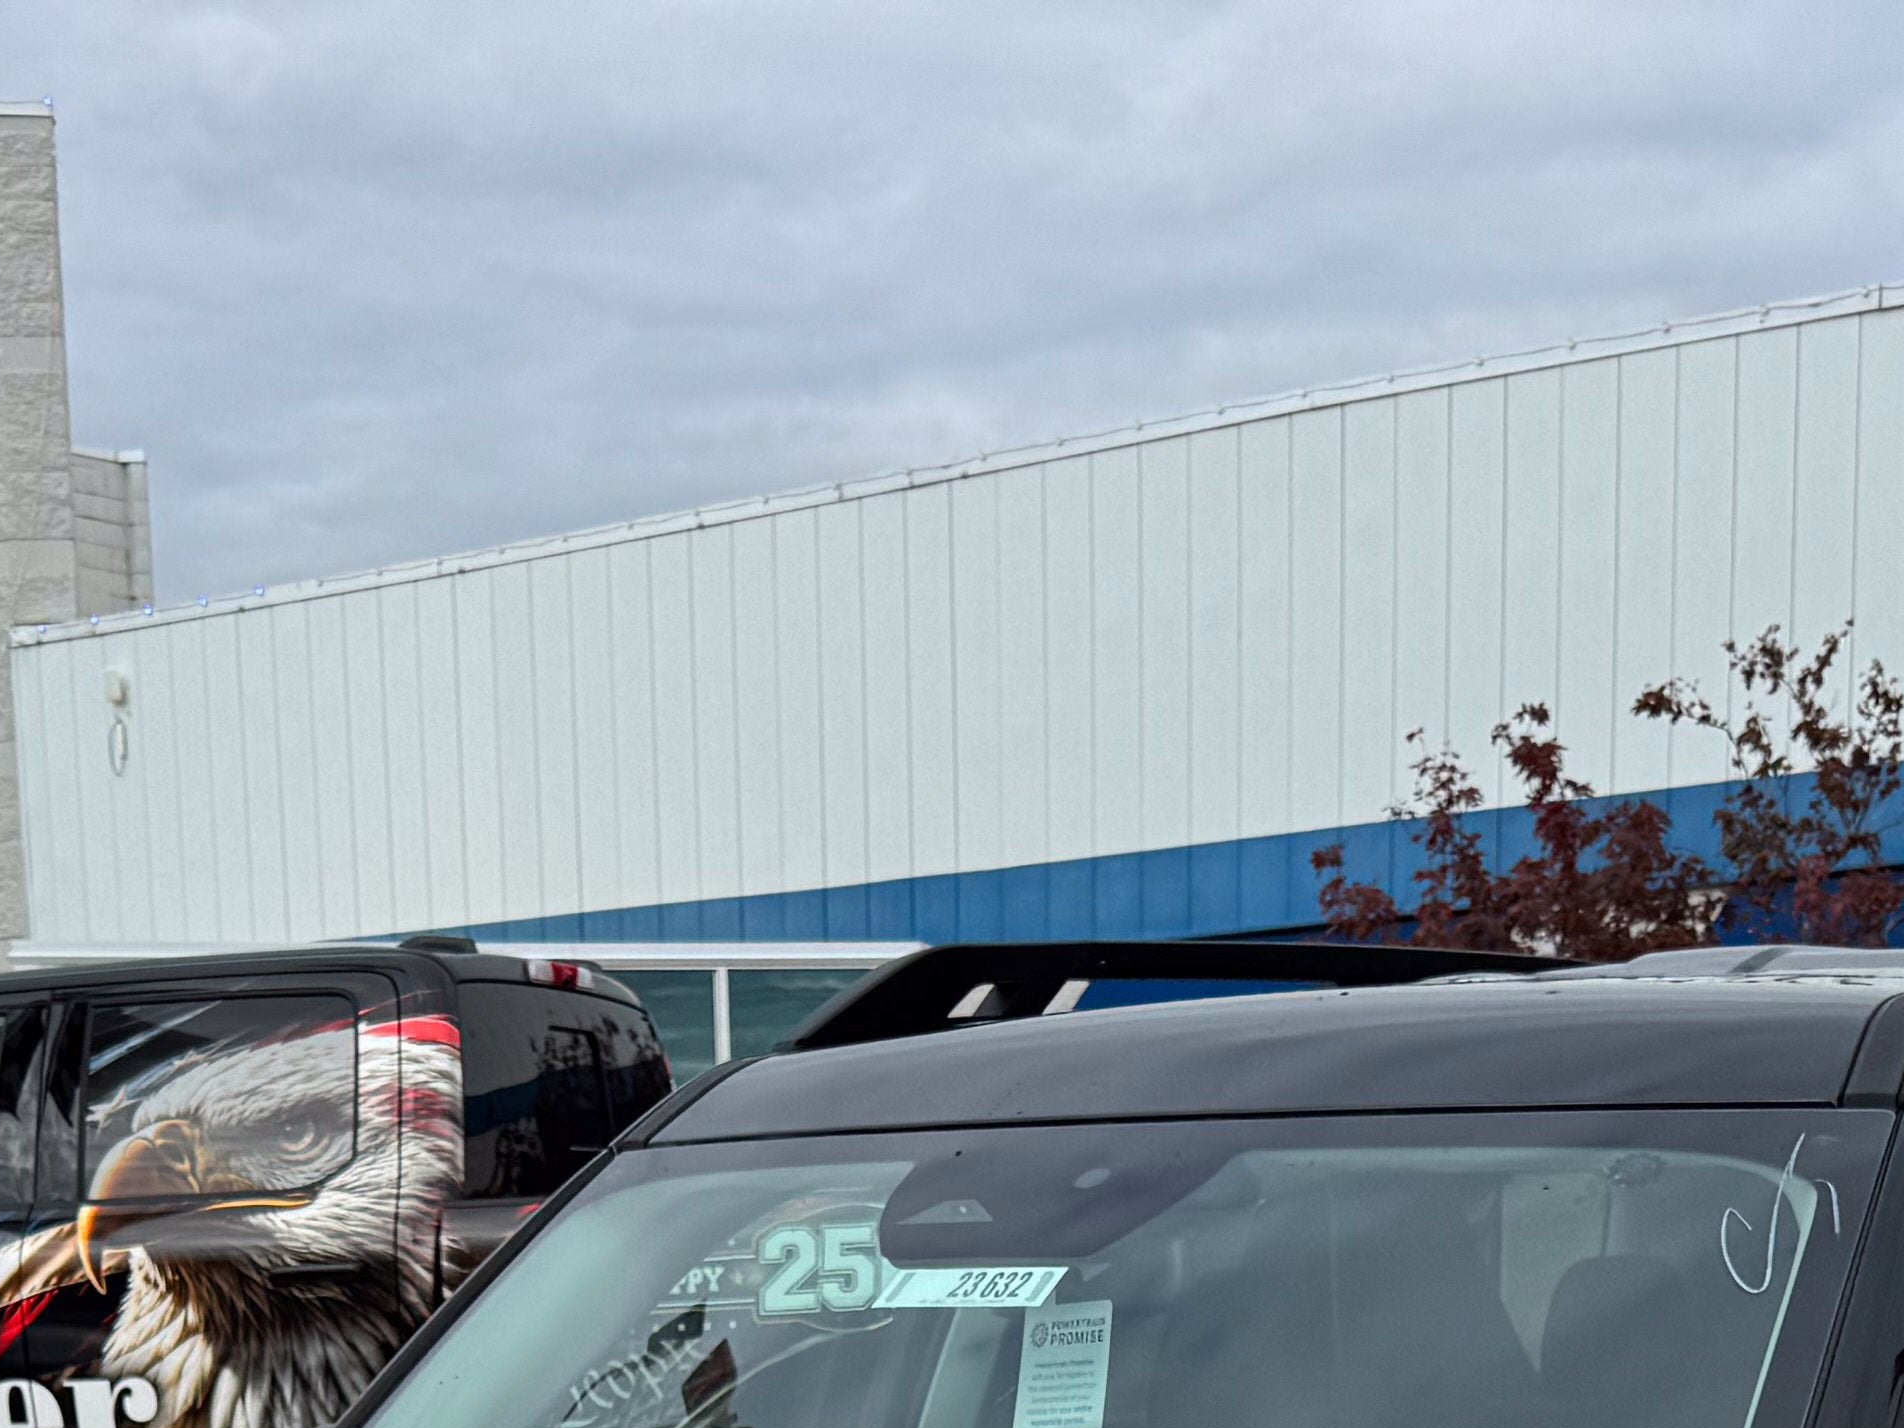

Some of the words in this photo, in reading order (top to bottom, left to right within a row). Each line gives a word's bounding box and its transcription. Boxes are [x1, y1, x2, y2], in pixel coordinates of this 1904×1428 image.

[757, 1222, 881, 1316] 25
[946, 1271, 1034, 1299] 23632
[1050, 1329, 1105, 1346] PROMISE
